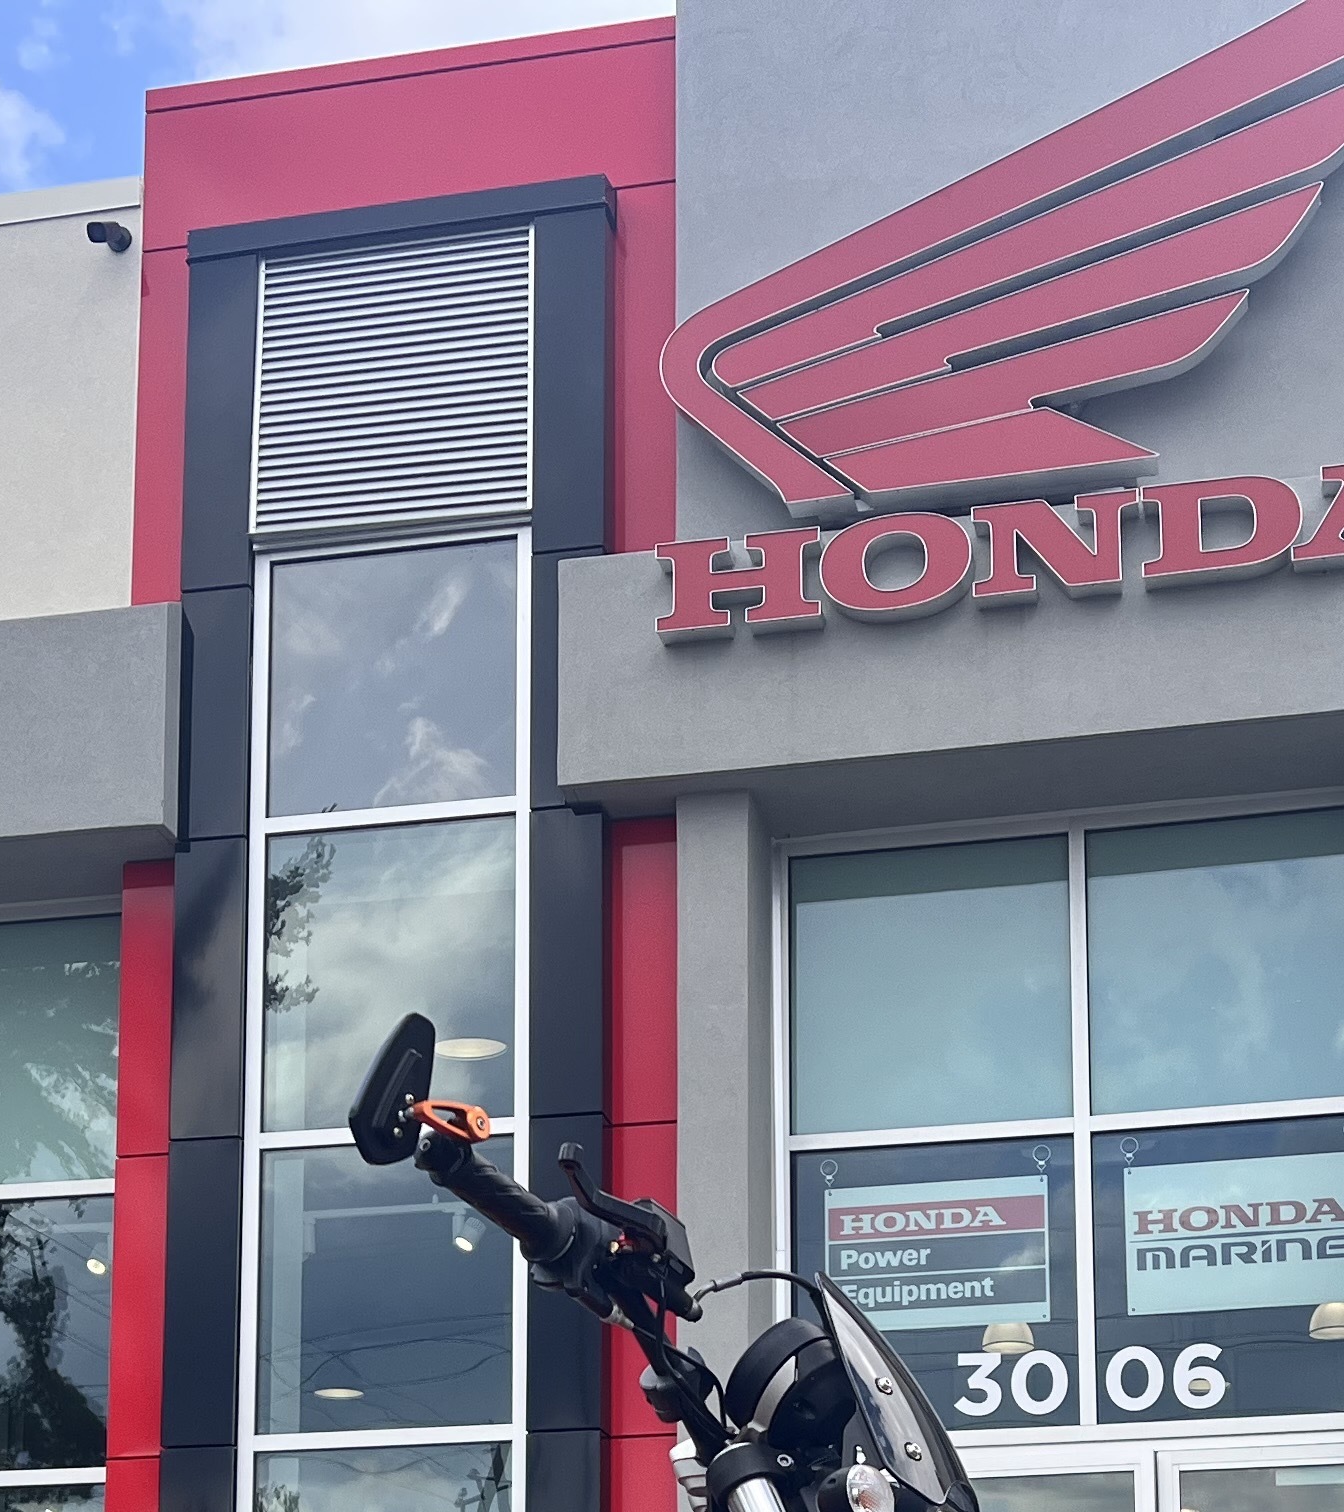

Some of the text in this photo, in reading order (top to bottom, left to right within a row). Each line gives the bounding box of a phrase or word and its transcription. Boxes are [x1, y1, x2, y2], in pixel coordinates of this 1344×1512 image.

[840, 1205, 1006, 1235] HONDA
[840, 1246, 931, 1270] Power
[846, 1276, 995, 1307] Equipment
